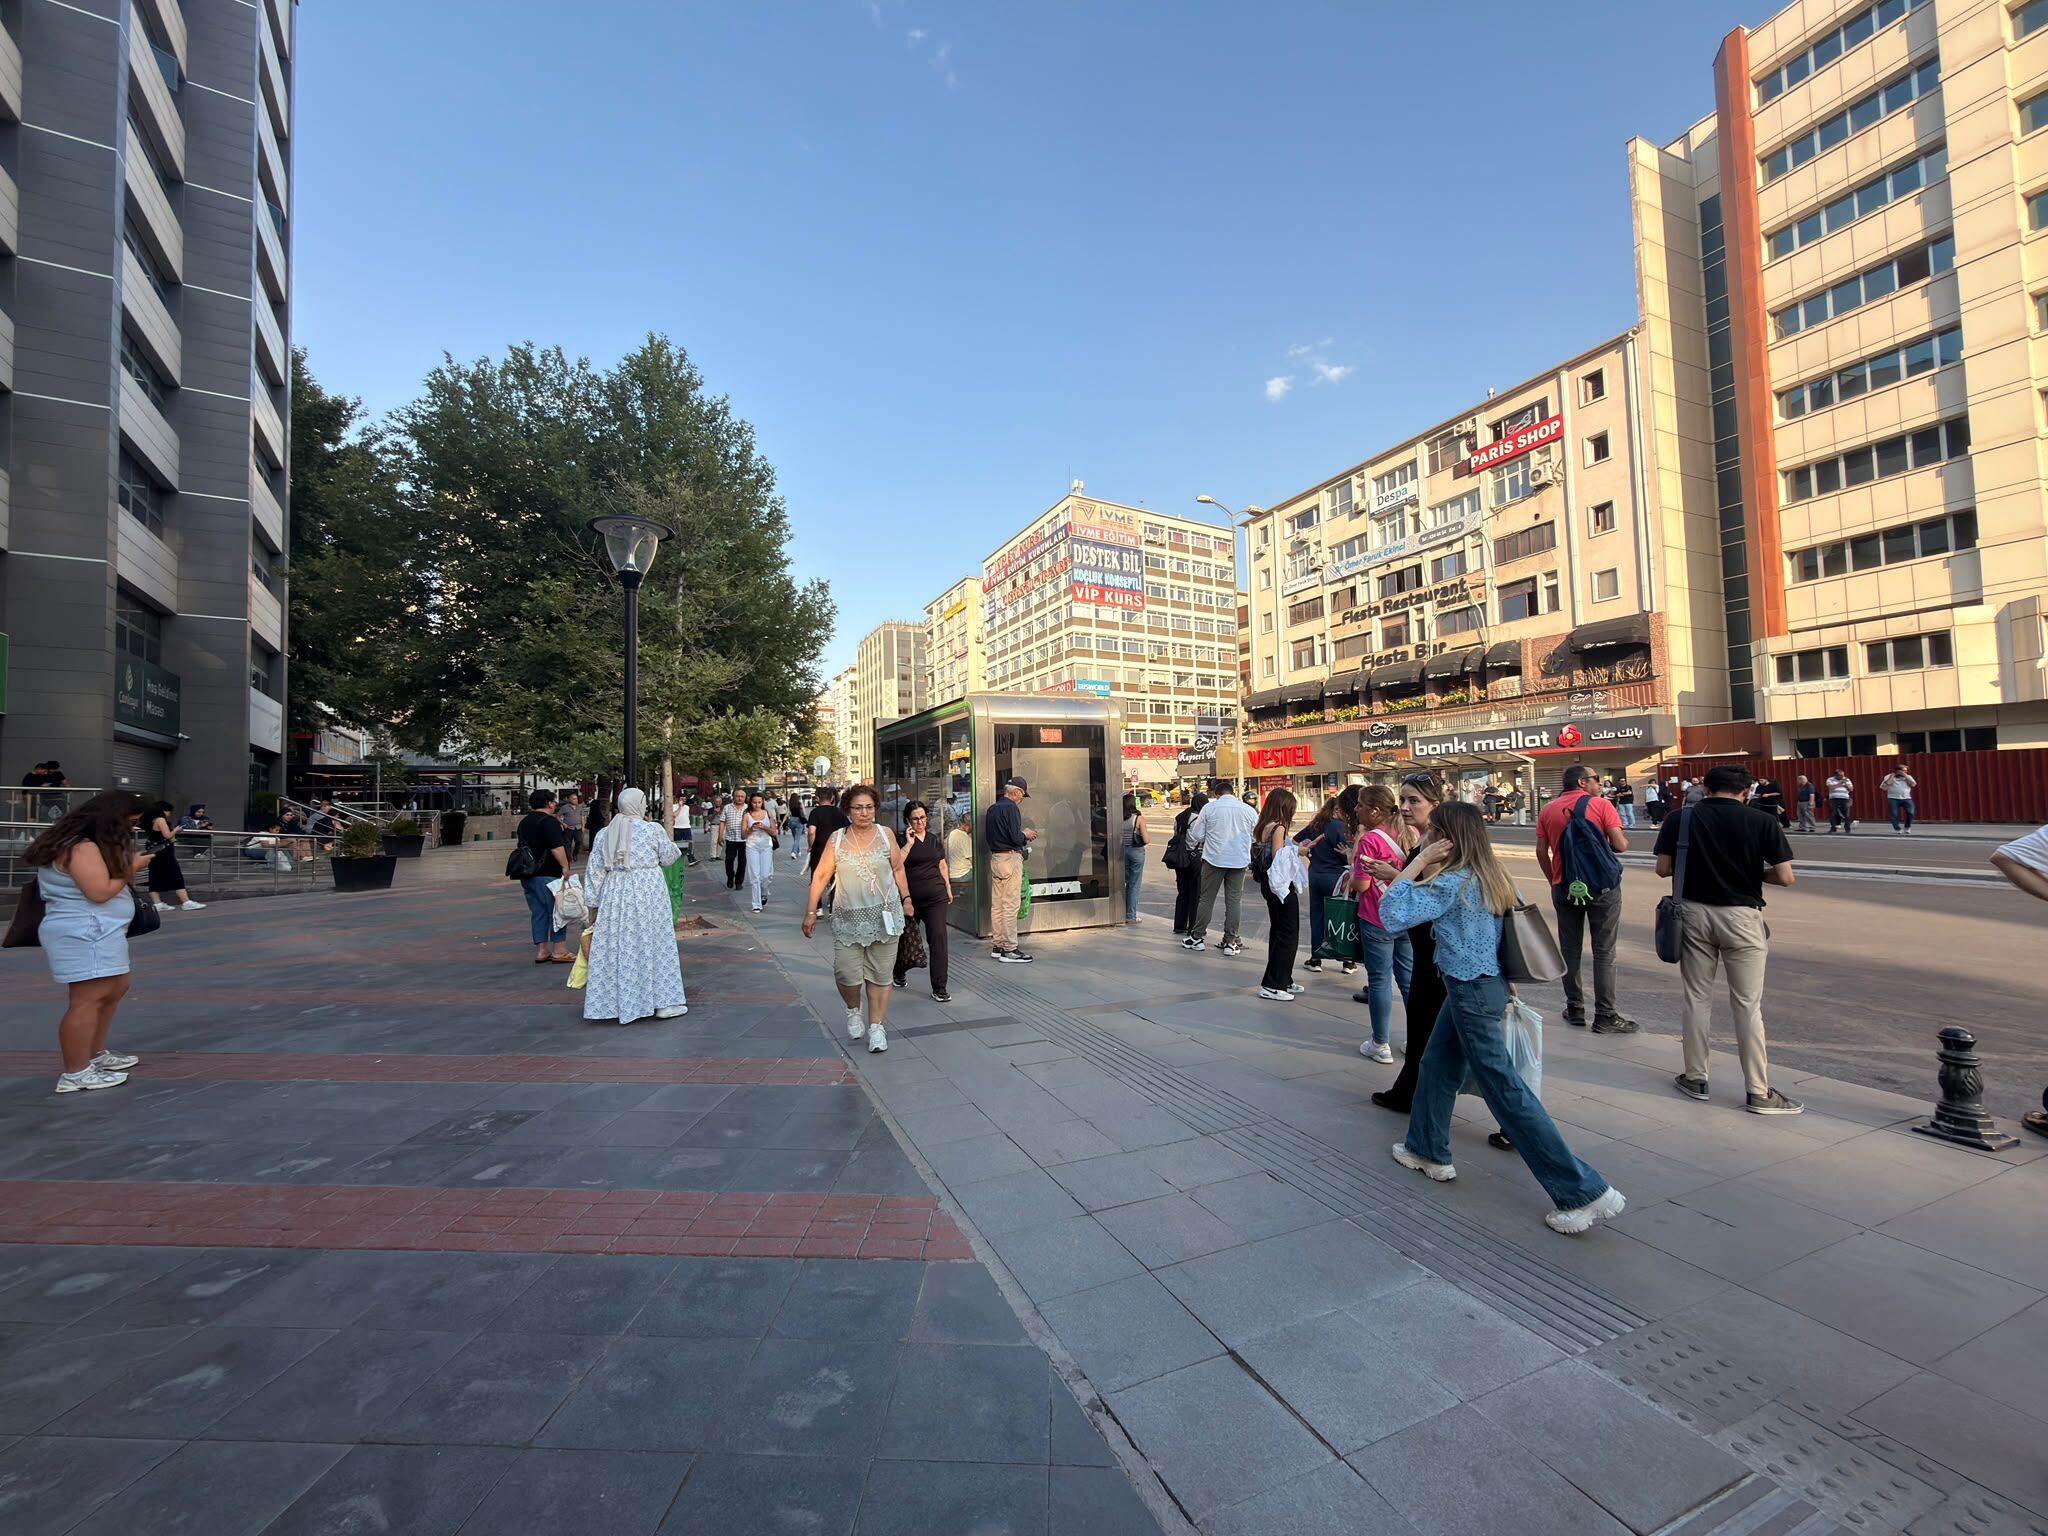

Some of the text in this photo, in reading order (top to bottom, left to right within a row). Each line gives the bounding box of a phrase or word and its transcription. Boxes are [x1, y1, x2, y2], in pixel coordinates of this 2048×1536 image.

[1471, 440, 1514, 468] PARİS
[1517, 420, 1561, 449] SHOP
[1377, 487, 1408, 507] Despa
[1099, 506, 1134, 525] İVME
[1028, 529, 1066, 561] KURUMLARI
[1076, 525, 1136, 545] İVME EĞİTİM
[1073, 543, 1142, 573] DESTEK BİL
[1363, 553, 1382, 563] Faruk
[1384, 543, 1406, 556] Ekinci
[1073, 567, 1104, 585] KOÇLUK
[1075, 585, 1143, 607] VİP KURS
[1342, 578, 1467, 626] Fiesta Restaurant
[1361, 642, 1447, 670] Fiesta Bar
[1248, 744, 1317, 769] VESTEL
[1415, 731, 1550, 757] bank mellat
